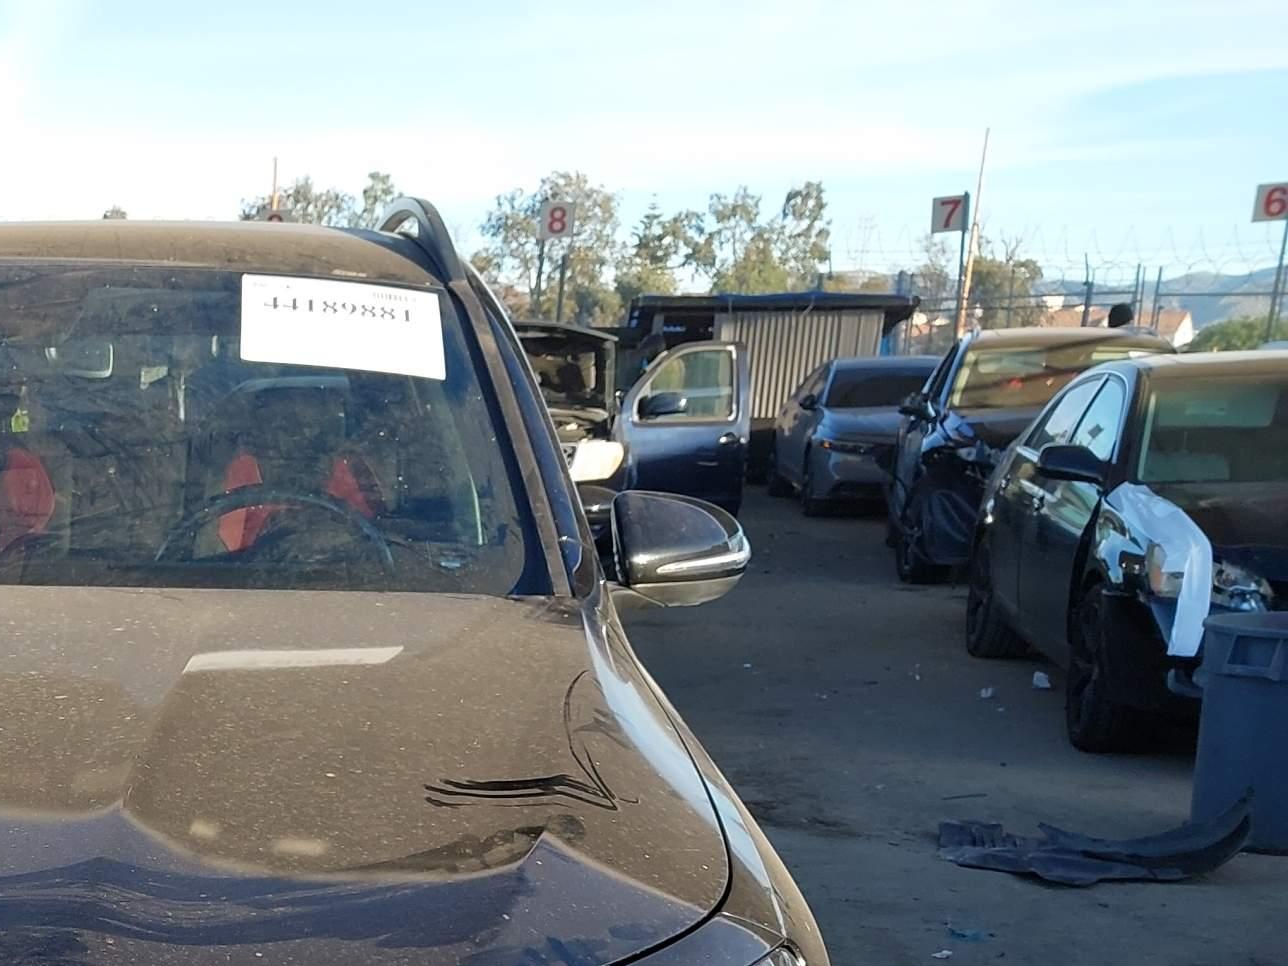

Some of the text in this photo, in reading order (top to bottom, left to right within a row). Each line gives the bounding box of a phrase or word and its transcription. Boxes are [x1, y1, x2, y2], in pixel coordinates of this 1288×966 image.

[940, 199, 962, 229] 7
[1264, 187, 1288, 217] 6
[548, 206, 566, 235] 8
[264, 296, 410, 322] 44189881
